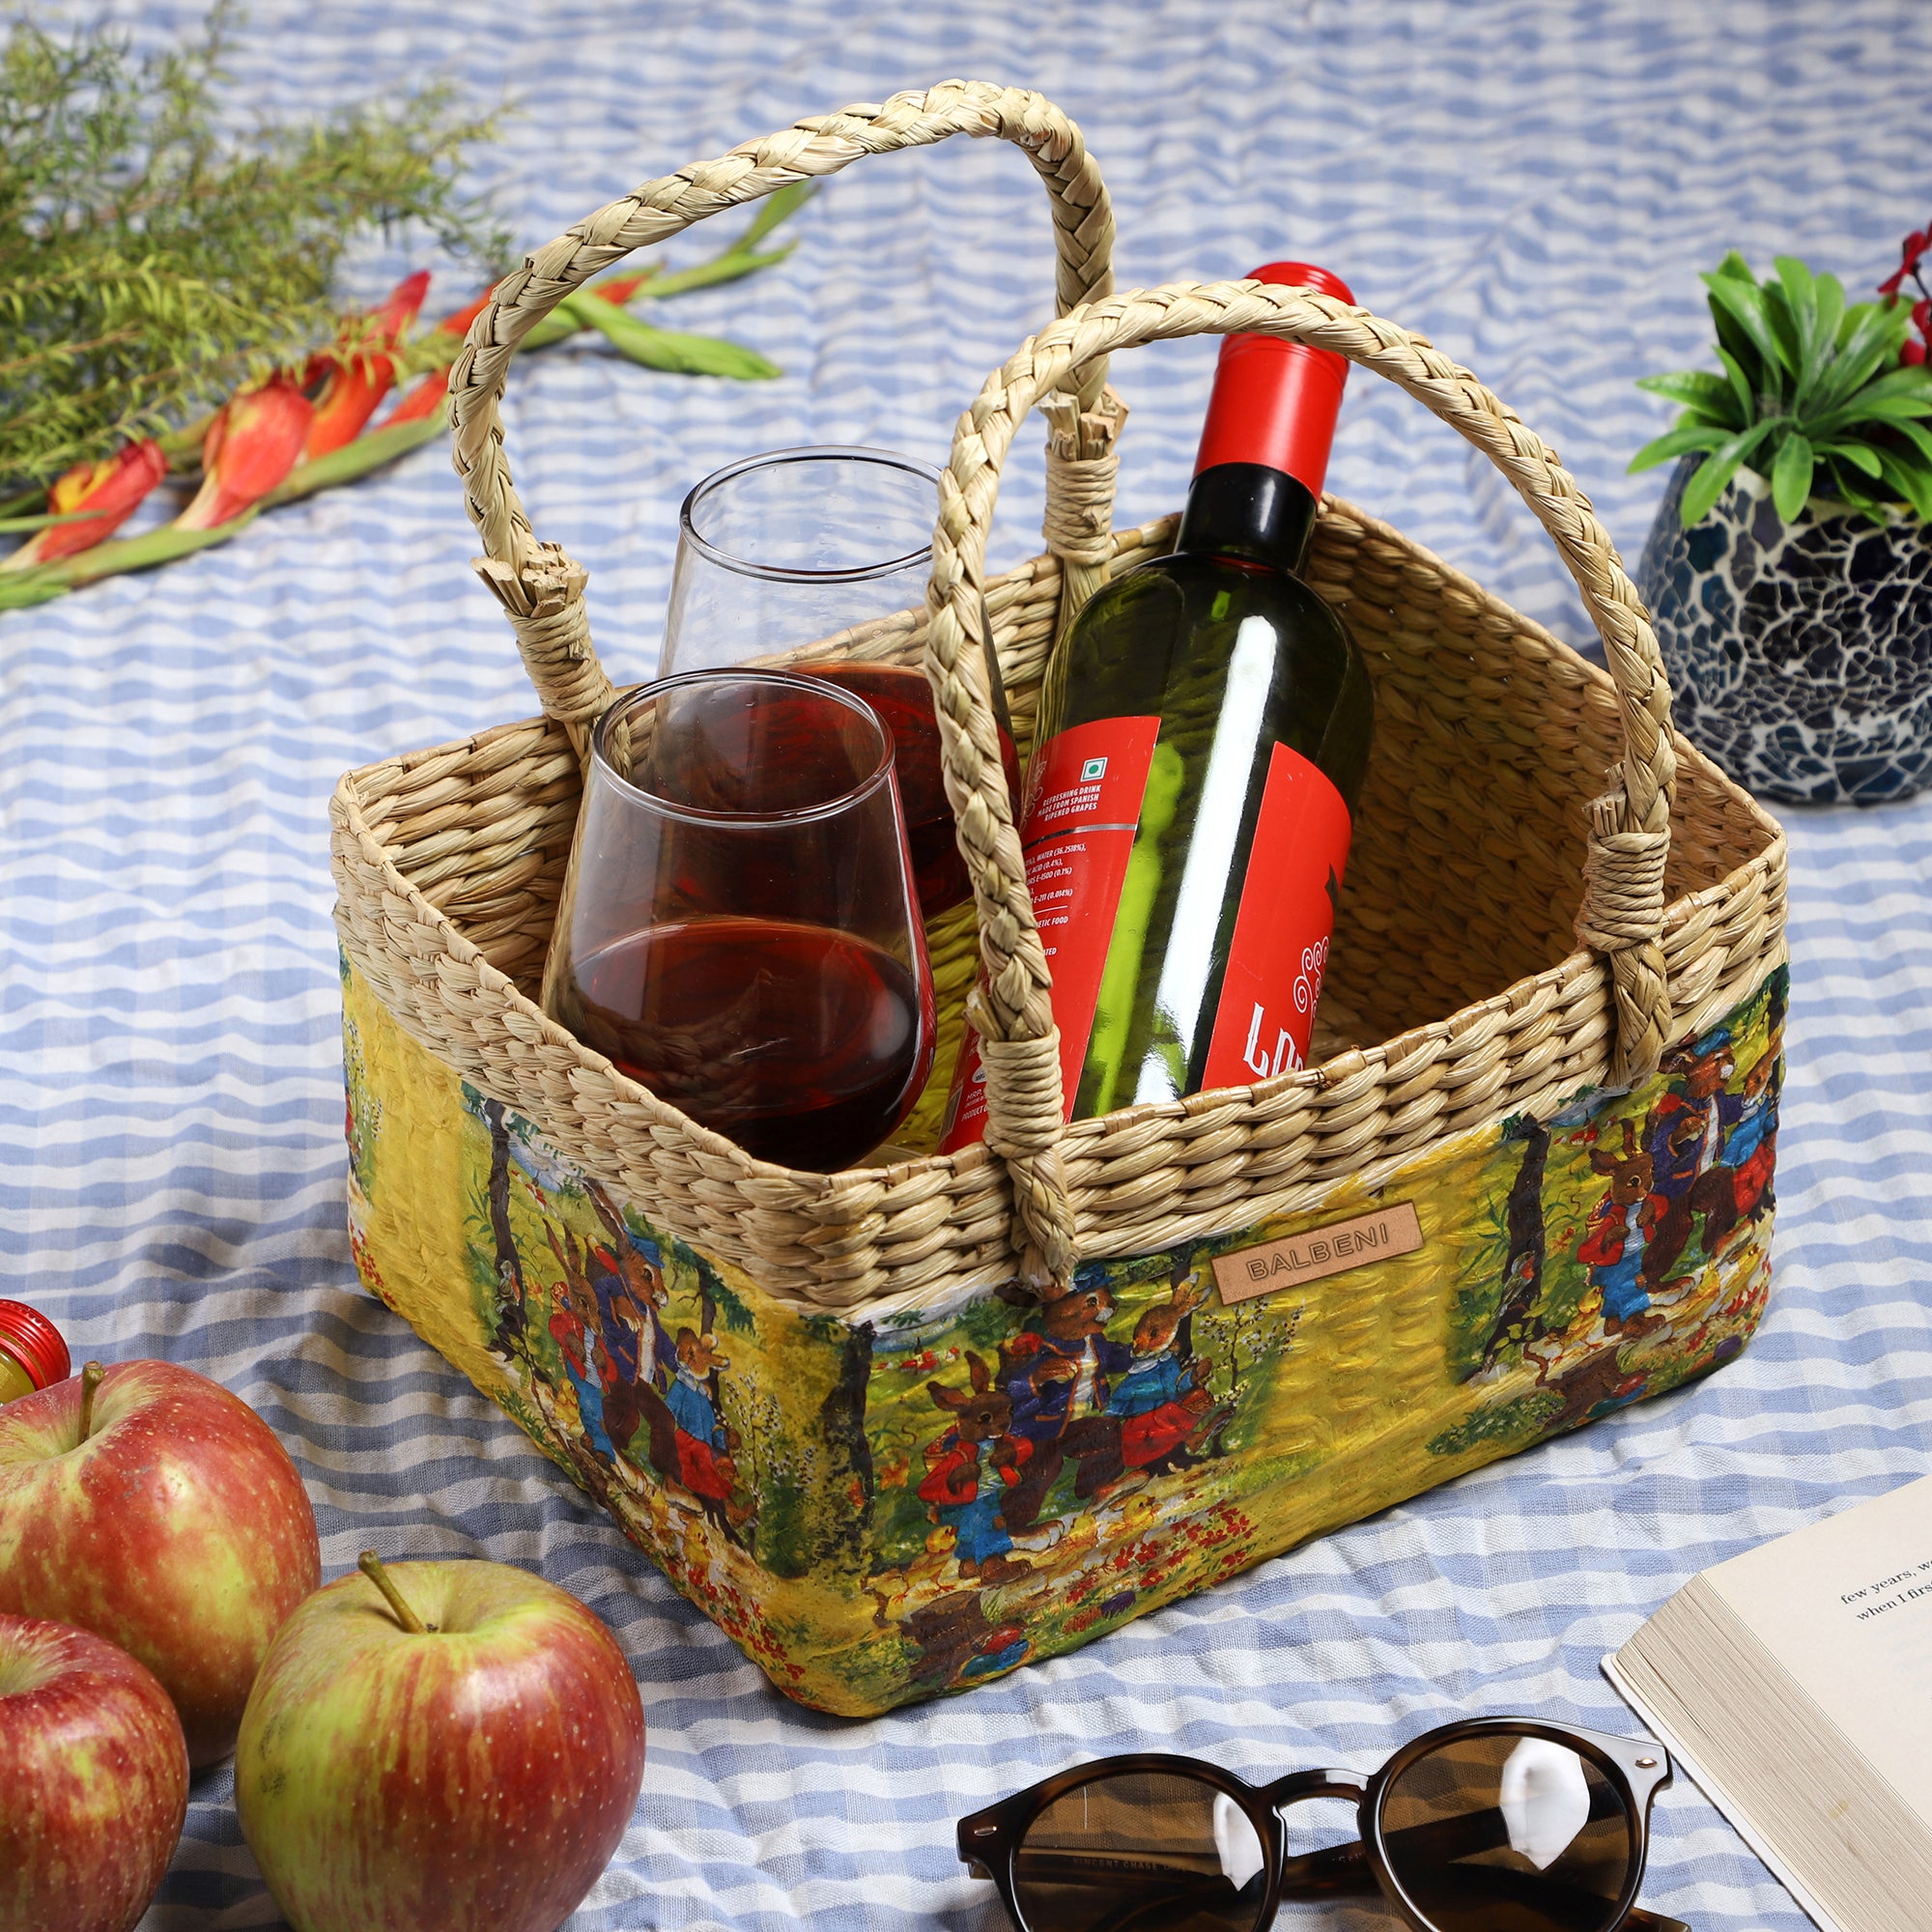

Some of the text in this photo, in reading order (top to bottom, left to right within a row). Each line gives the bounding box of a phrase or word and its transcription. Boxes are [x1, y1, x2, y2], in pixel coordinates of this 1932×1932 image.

[1037, 793, 1099, 817] MADE FROM SPANISH
[1042, 784, 1101, 807] REFRESHING DRINK
[1044, 803, 1097, 822] RIPENED GRAPES
[1052, 916, 1068, 925] FOOD
[1245, 1222, 1389, 1281] BALBENI
[1840, 1587, 1867, 1605] few
[1870, 1570, 1917, 1594] years,
[1856, 1600, 1898, 1621] when
[1897, 1593, 1908, 1604] I
